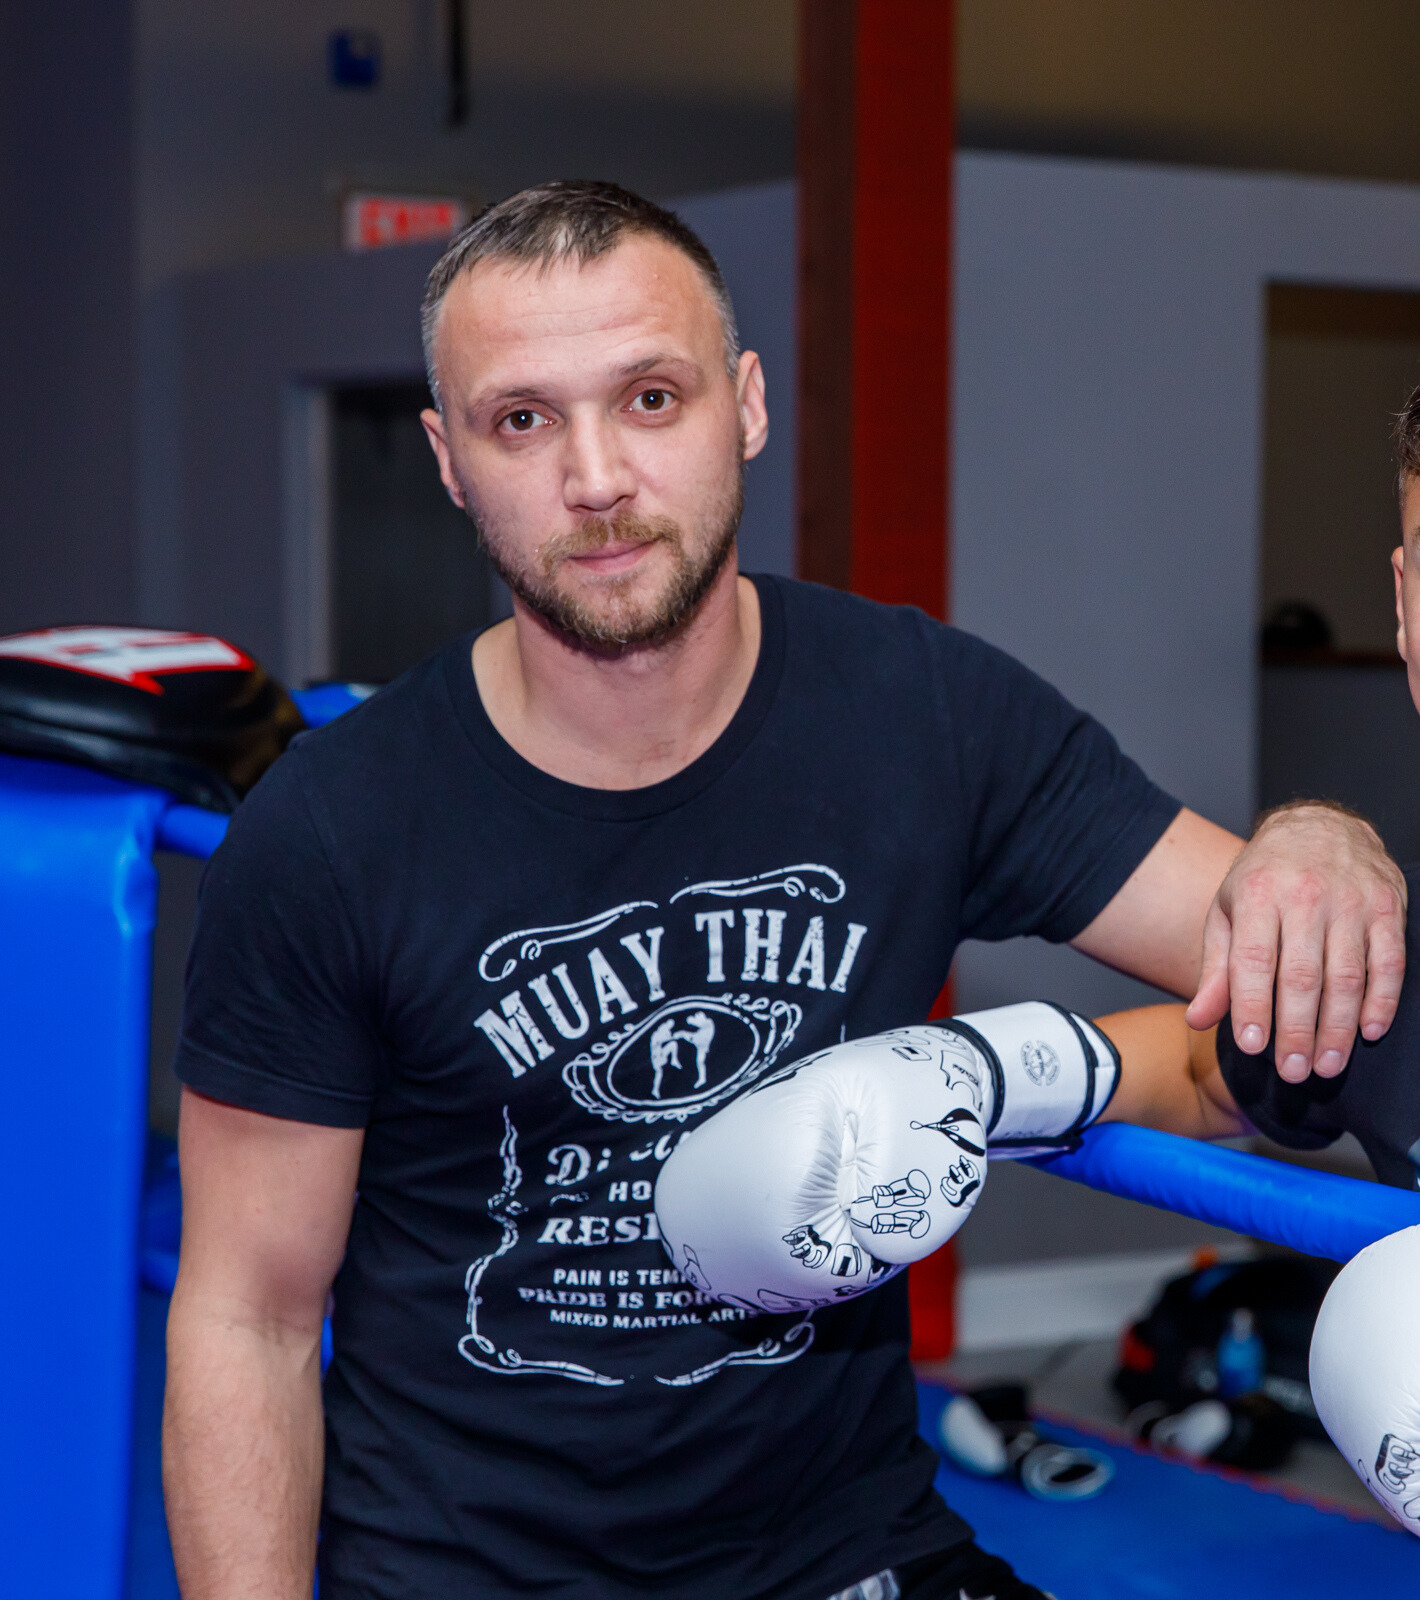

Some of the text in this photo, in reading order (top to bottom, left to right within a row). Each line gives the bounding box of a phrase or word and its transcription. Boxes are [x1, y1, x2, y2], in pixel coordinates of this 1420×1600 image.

[473, 908, 868, 1079] MUAY THAI
[608, 1180, 652, 1202] HO
[553, 1268, 602, 1286] PAIN
[609, 1269, 629, 1286] IS
[517, 1287, 607, 1308] PRIDE
[617, 1291, 644, 1309] IS
[550, 1309, 608, 1327] MIXED
[613, 1312, 702, 1329] MARTIAL
